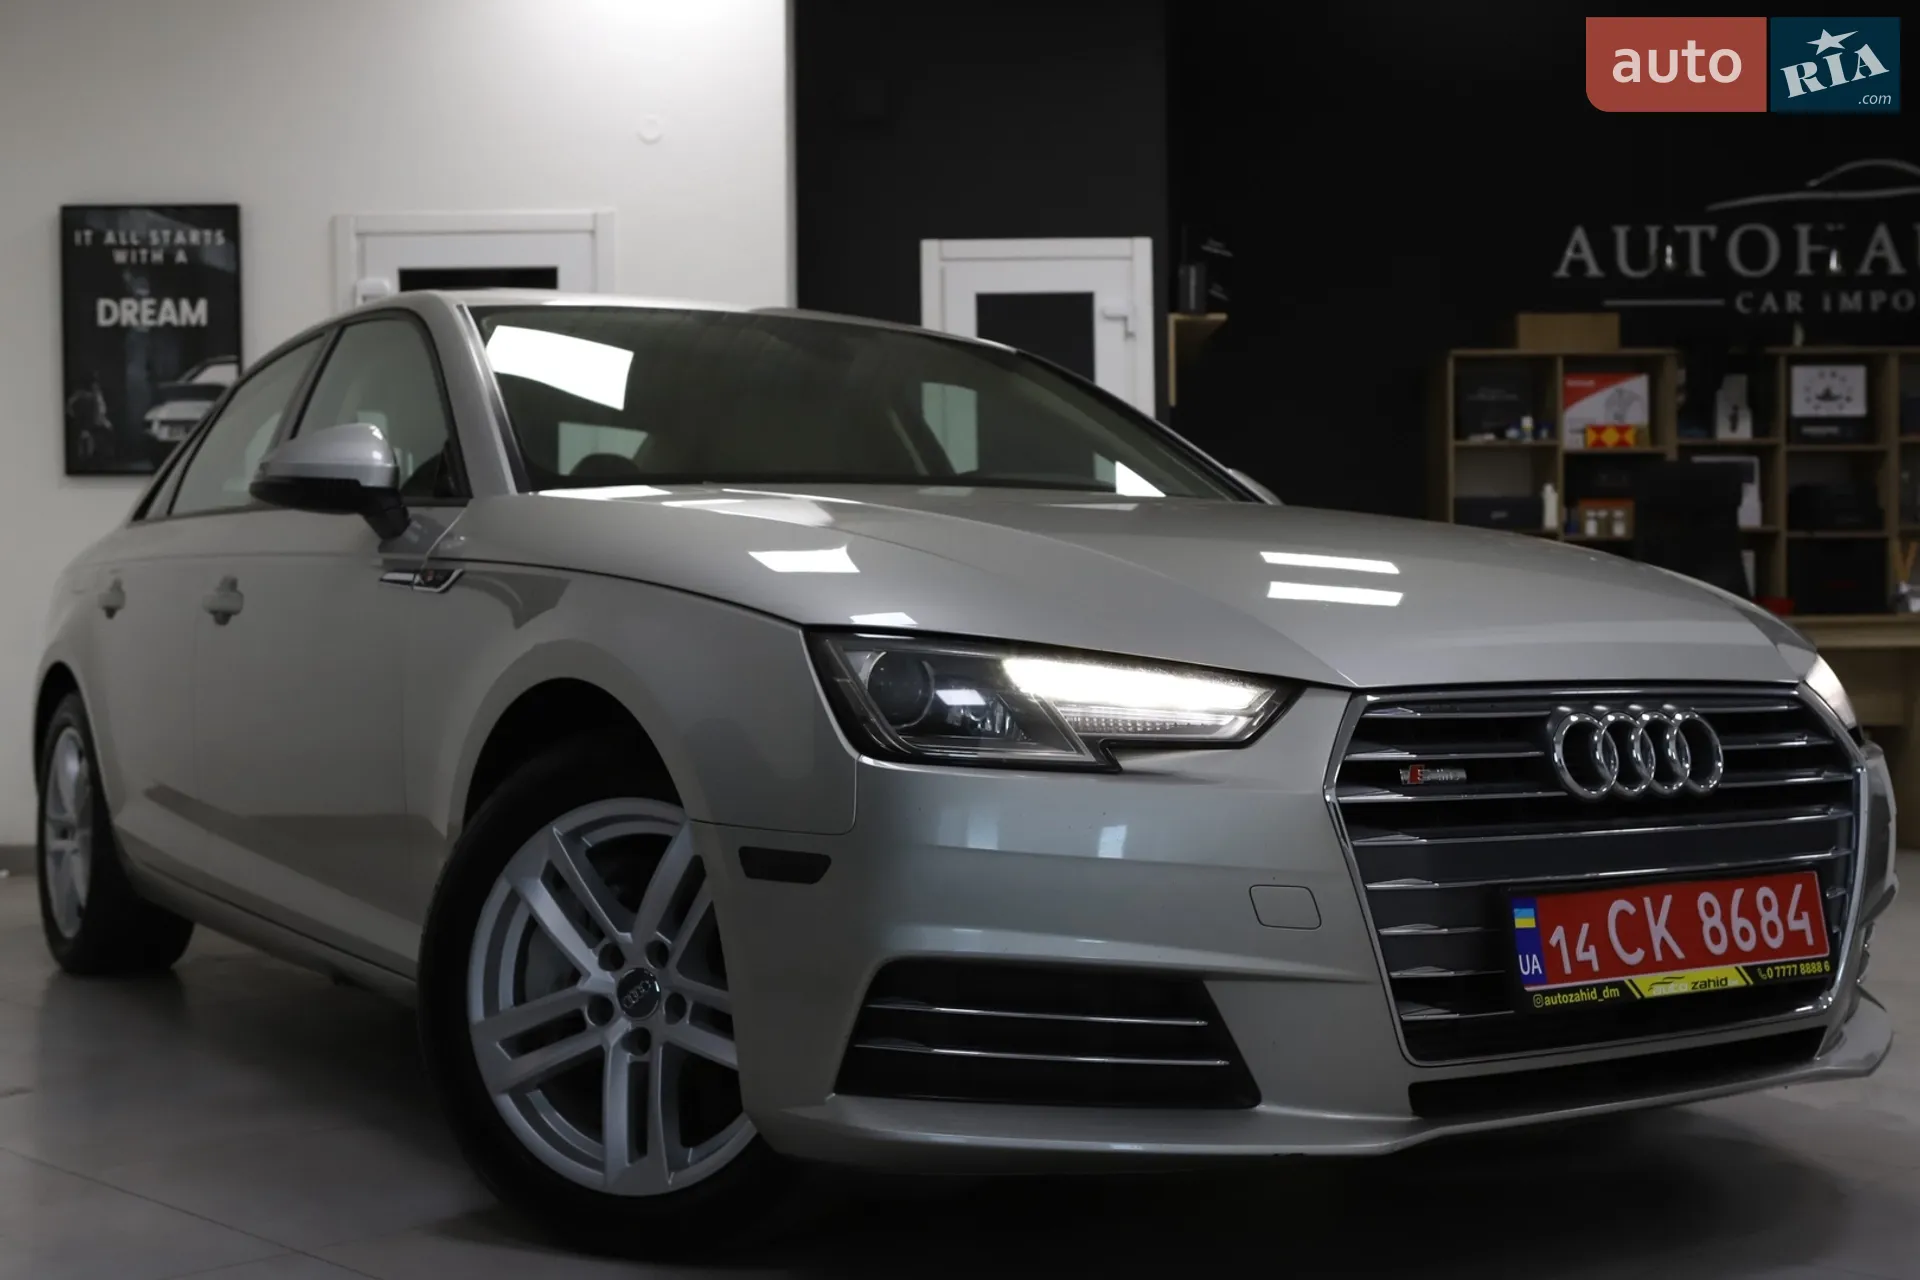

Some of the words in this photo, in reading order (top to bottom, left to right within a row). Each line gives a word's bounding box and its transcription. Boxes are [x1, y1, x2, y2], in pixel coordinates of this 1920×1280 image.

[74, 229, 94, 246] IT
[103, 229, 140, 246] ALL
[149, 228, 225, 246] STARTS
[112, 248, 165, 264] WITH
[174, 248, 189, 265] A
[1552, 221, 1920, 278] AUTOHA
[96, 297, 209, 327] DREAM
[1735, 290, 1804, 314] CAR
[1821, 289, 1920, 313] IMPO
[1549, 922, 1600, 975] 14
[1607, 894, 1686, 966] CK
[1697, 883, 1815, 956] 8684
[1519, 954, 1543, 976] UA
[1691, 976, 1729, 991] zahid
